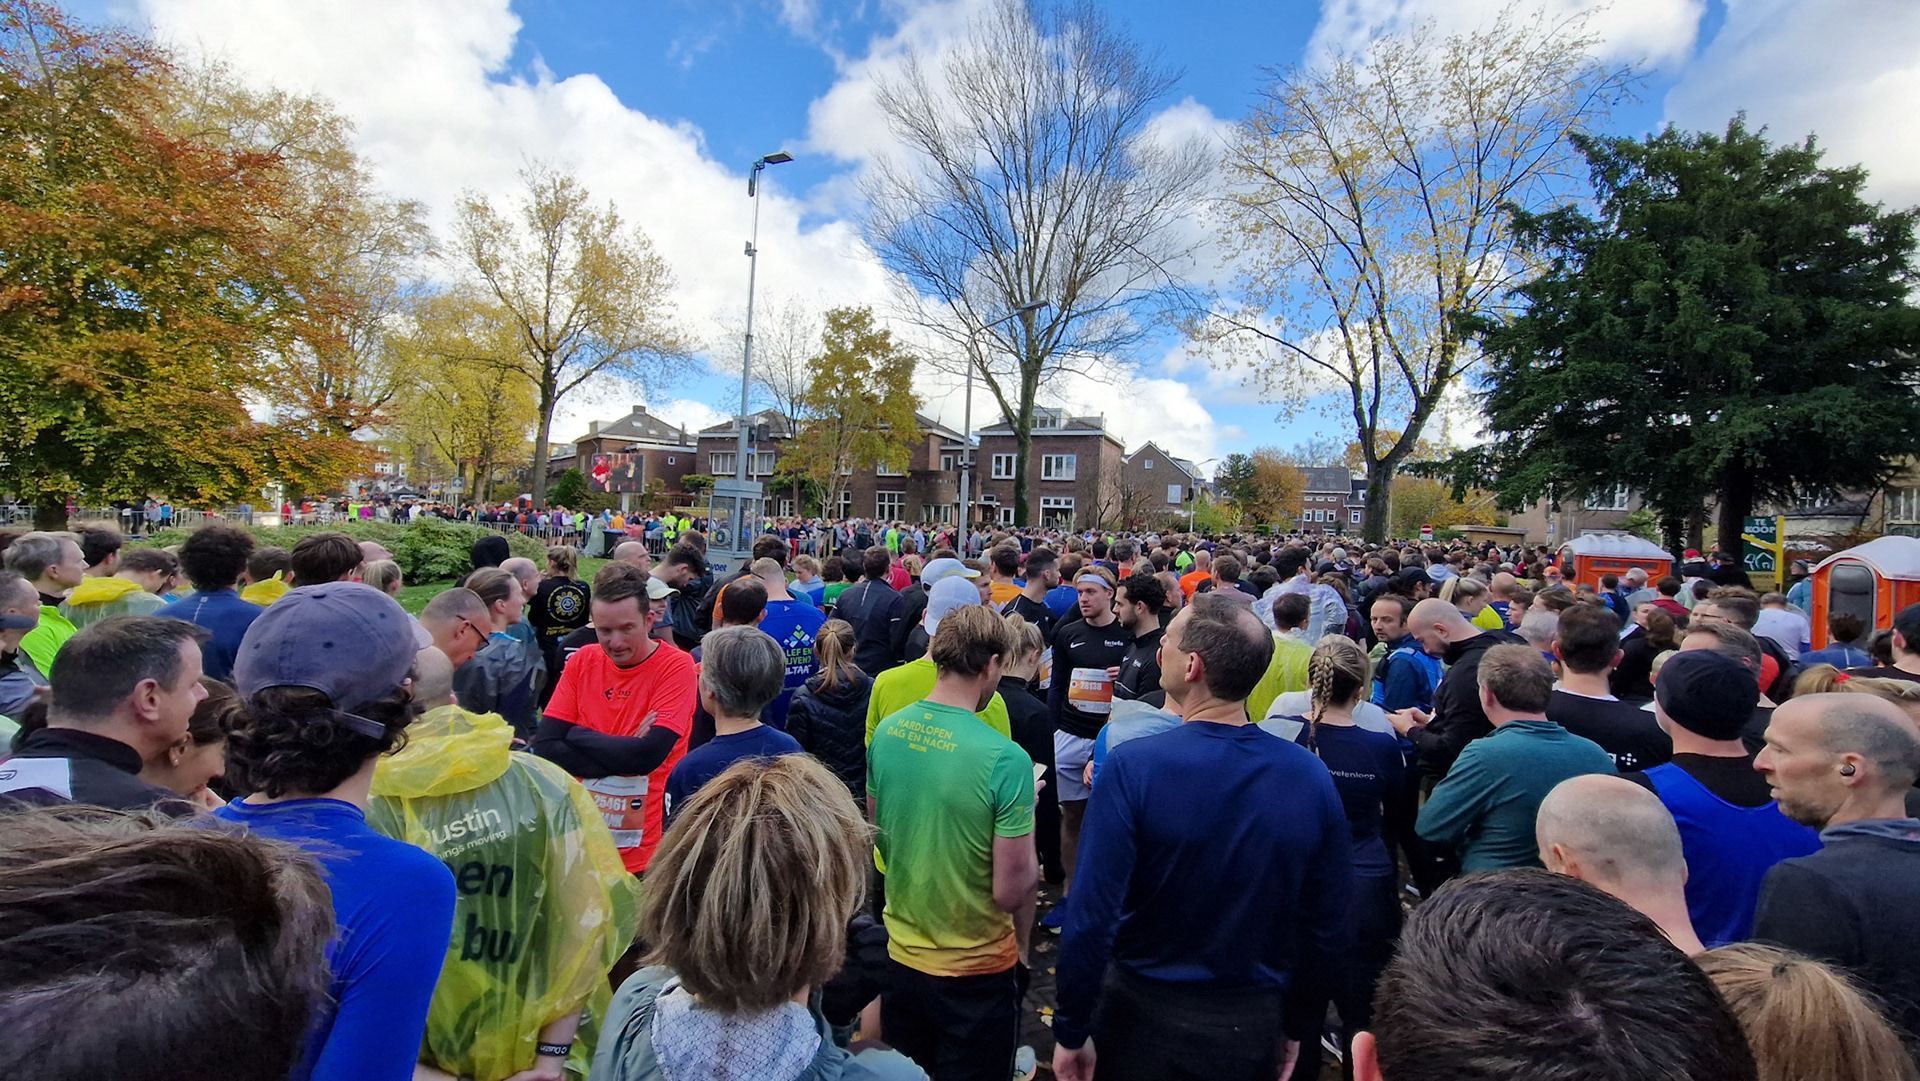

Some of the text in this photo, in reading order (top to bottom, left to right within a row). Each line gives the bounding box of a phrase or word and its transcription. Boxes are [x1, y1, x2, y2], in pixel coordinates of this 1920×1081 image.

[1744, 526, 1776, 534] KOOP
[1754, 518, 1767, 526] TE
[786, 648, 801, 657] LEF
[896, 718, 954, 740] HARDLOPEN
[886, 726, 906, 739] DAG
[907, 731, 921, 742] EN
[922, 736, 958, 753] NACHT
[594, 794, 627, 812] 25461
[429, 808, 502, 845] ustin
[466, 830, 508, 850] moving
[443, 860, 514, 898] en
